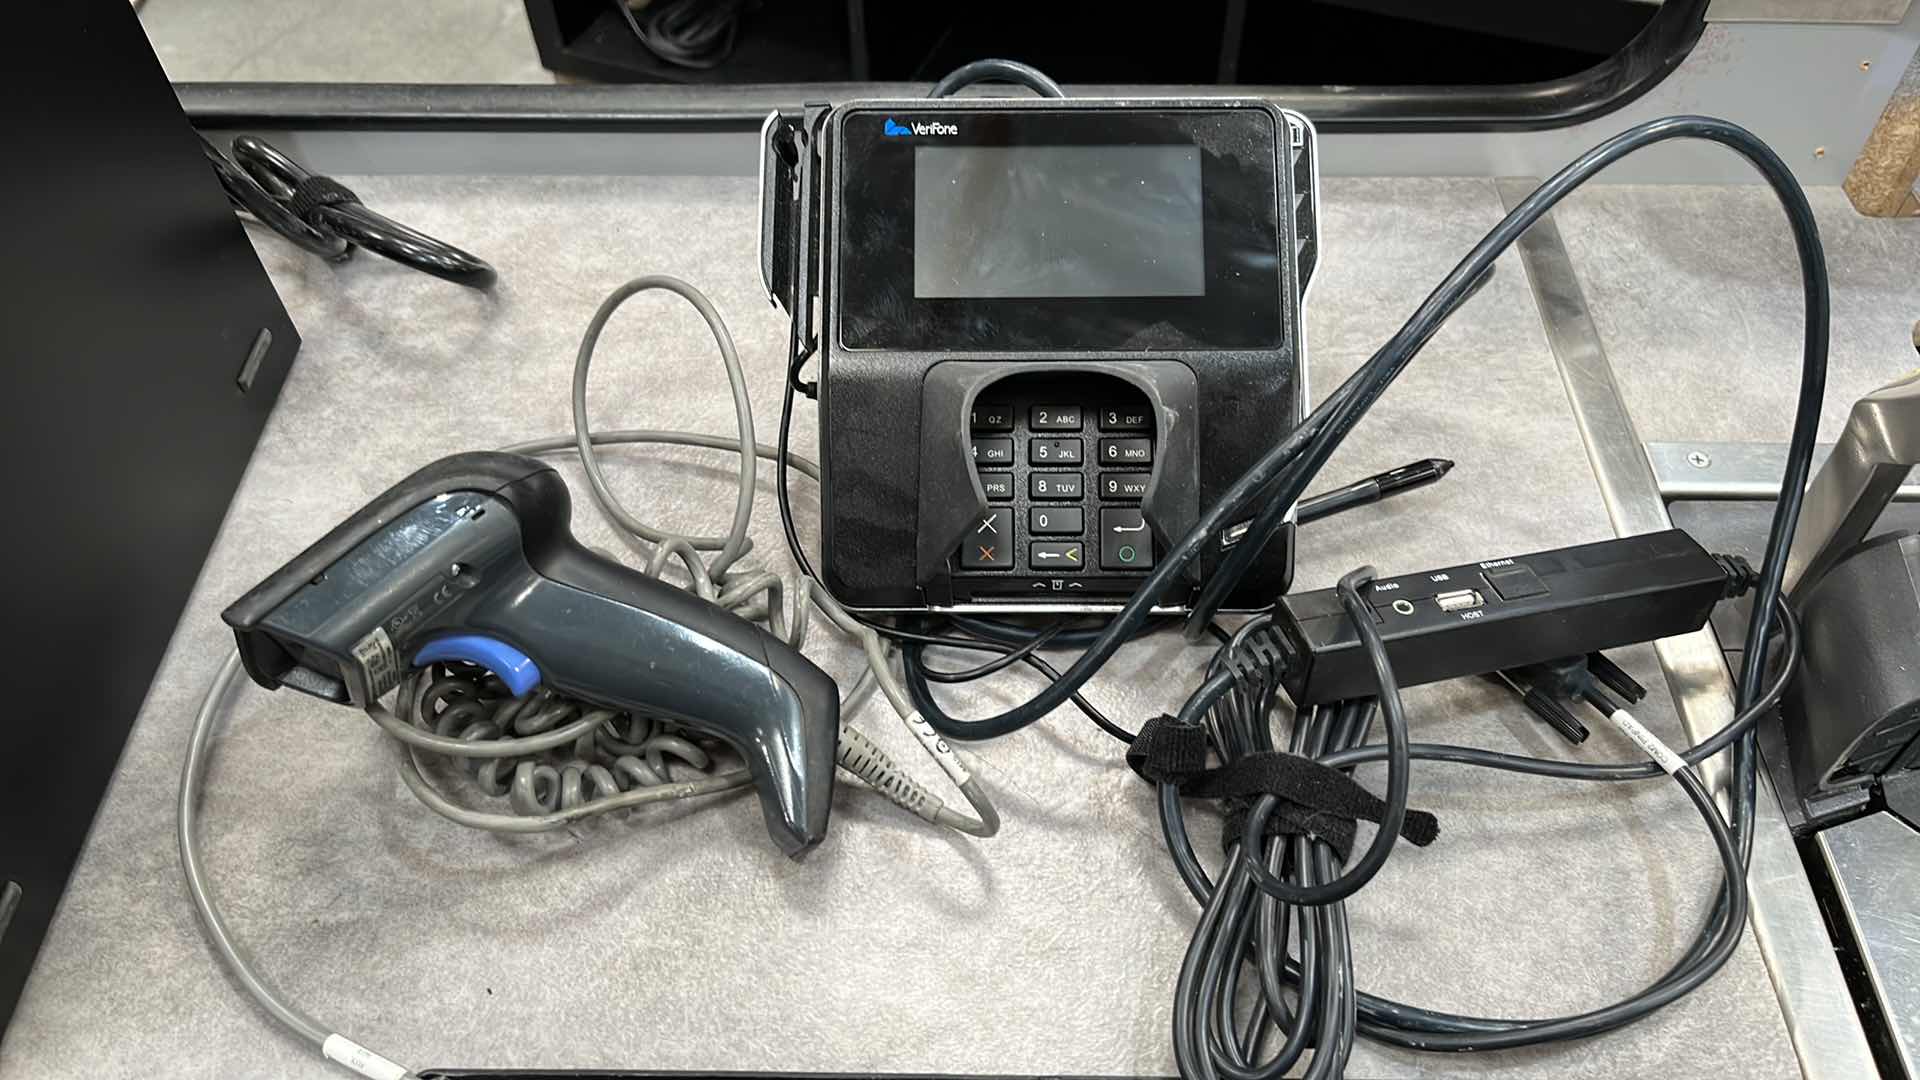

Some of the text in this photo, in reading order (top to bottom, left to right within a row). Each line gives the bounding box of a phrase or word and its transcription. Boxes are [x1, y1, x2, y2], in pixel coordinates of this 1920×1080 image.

[911, 122, 959, 136] VeriFone
[972, 412, 977, 424] 1
[1039, 411, 1075, 424] 2 ABC
[1108, 411, 1144, 424] 3 DEF
[987, 449, 1004, 458] GHI
[1039, 445, 1075, 459] 5 JKL
[1108, 445, 1146, 458] 6 MNO
[986, 483, 1006, 493] PRS
[1038, 480, 1076, 493] 8 TUV
[1108, 480, 1118, 493] 9
[1039, 514, 1048, 527] 0
[1479, 558, 1515, 569] Ethernet
[1430, 573, 1450, 582] USB
[1375, 582, 1400, 592] Audio
[1460, 610, 1485, 621] HOST
